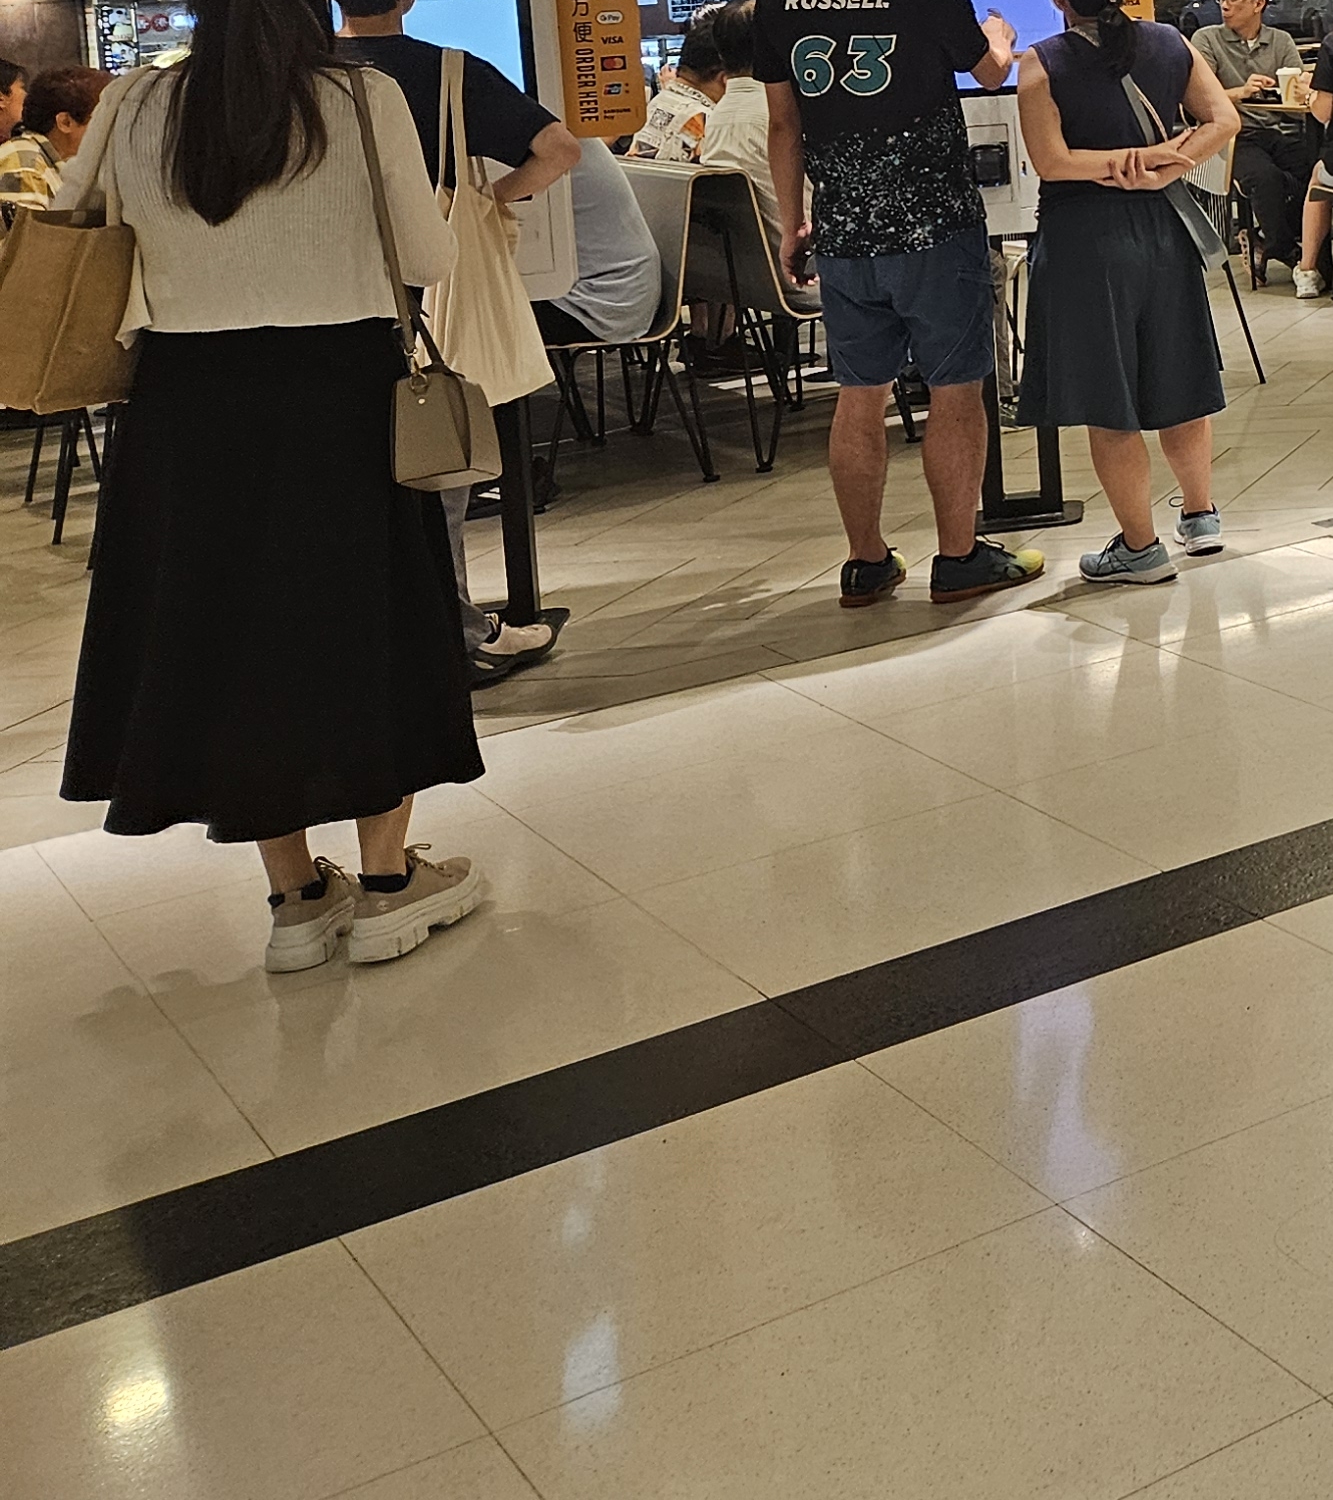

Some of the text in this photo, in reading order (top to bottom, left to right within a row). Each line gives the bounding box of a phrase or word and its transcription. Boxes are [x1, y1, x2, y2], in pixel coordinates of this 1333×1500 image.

[601, 36, 624, 45] VISA
[791, 34, 897, 97] 63
[575, 48, 599, 122] ORDER HERE
